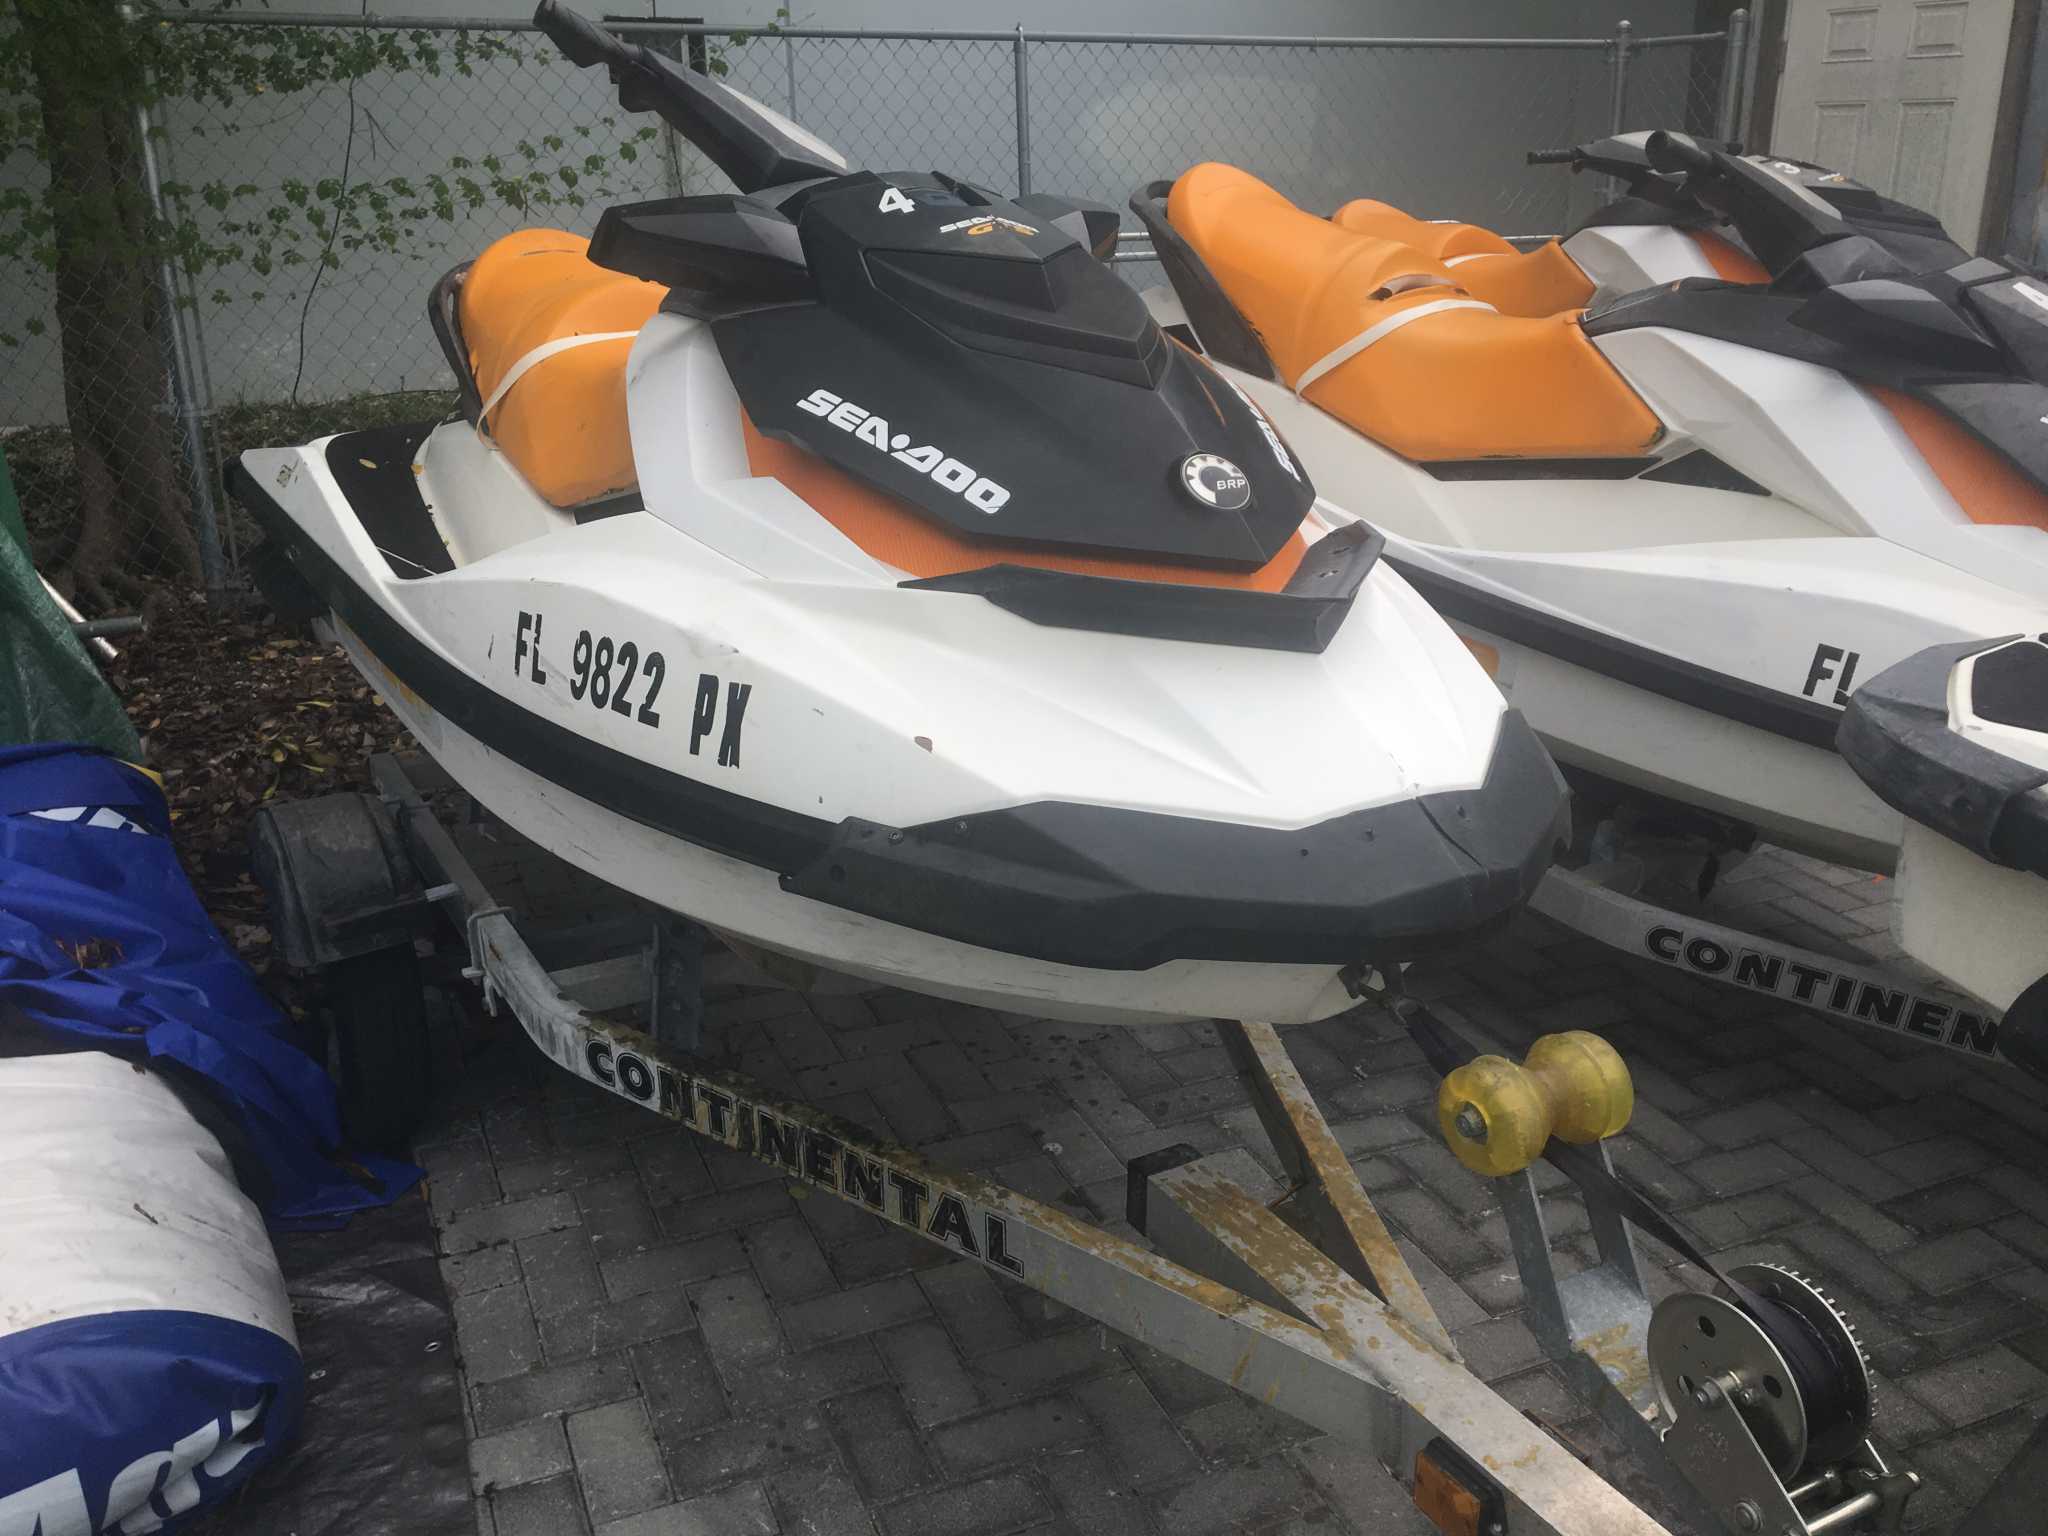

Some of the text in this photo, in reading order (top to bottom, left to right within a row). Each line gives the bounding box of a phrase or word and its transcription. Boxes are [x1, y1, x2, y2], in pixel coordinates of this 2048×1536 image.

[878, 187, 915, 214] 4
[1216, 479, 1246, 490] BRP
[514, 610, 752, 769] FL 9822 PX
[585, 1038, 1025, 1279] CONTINENTAL
